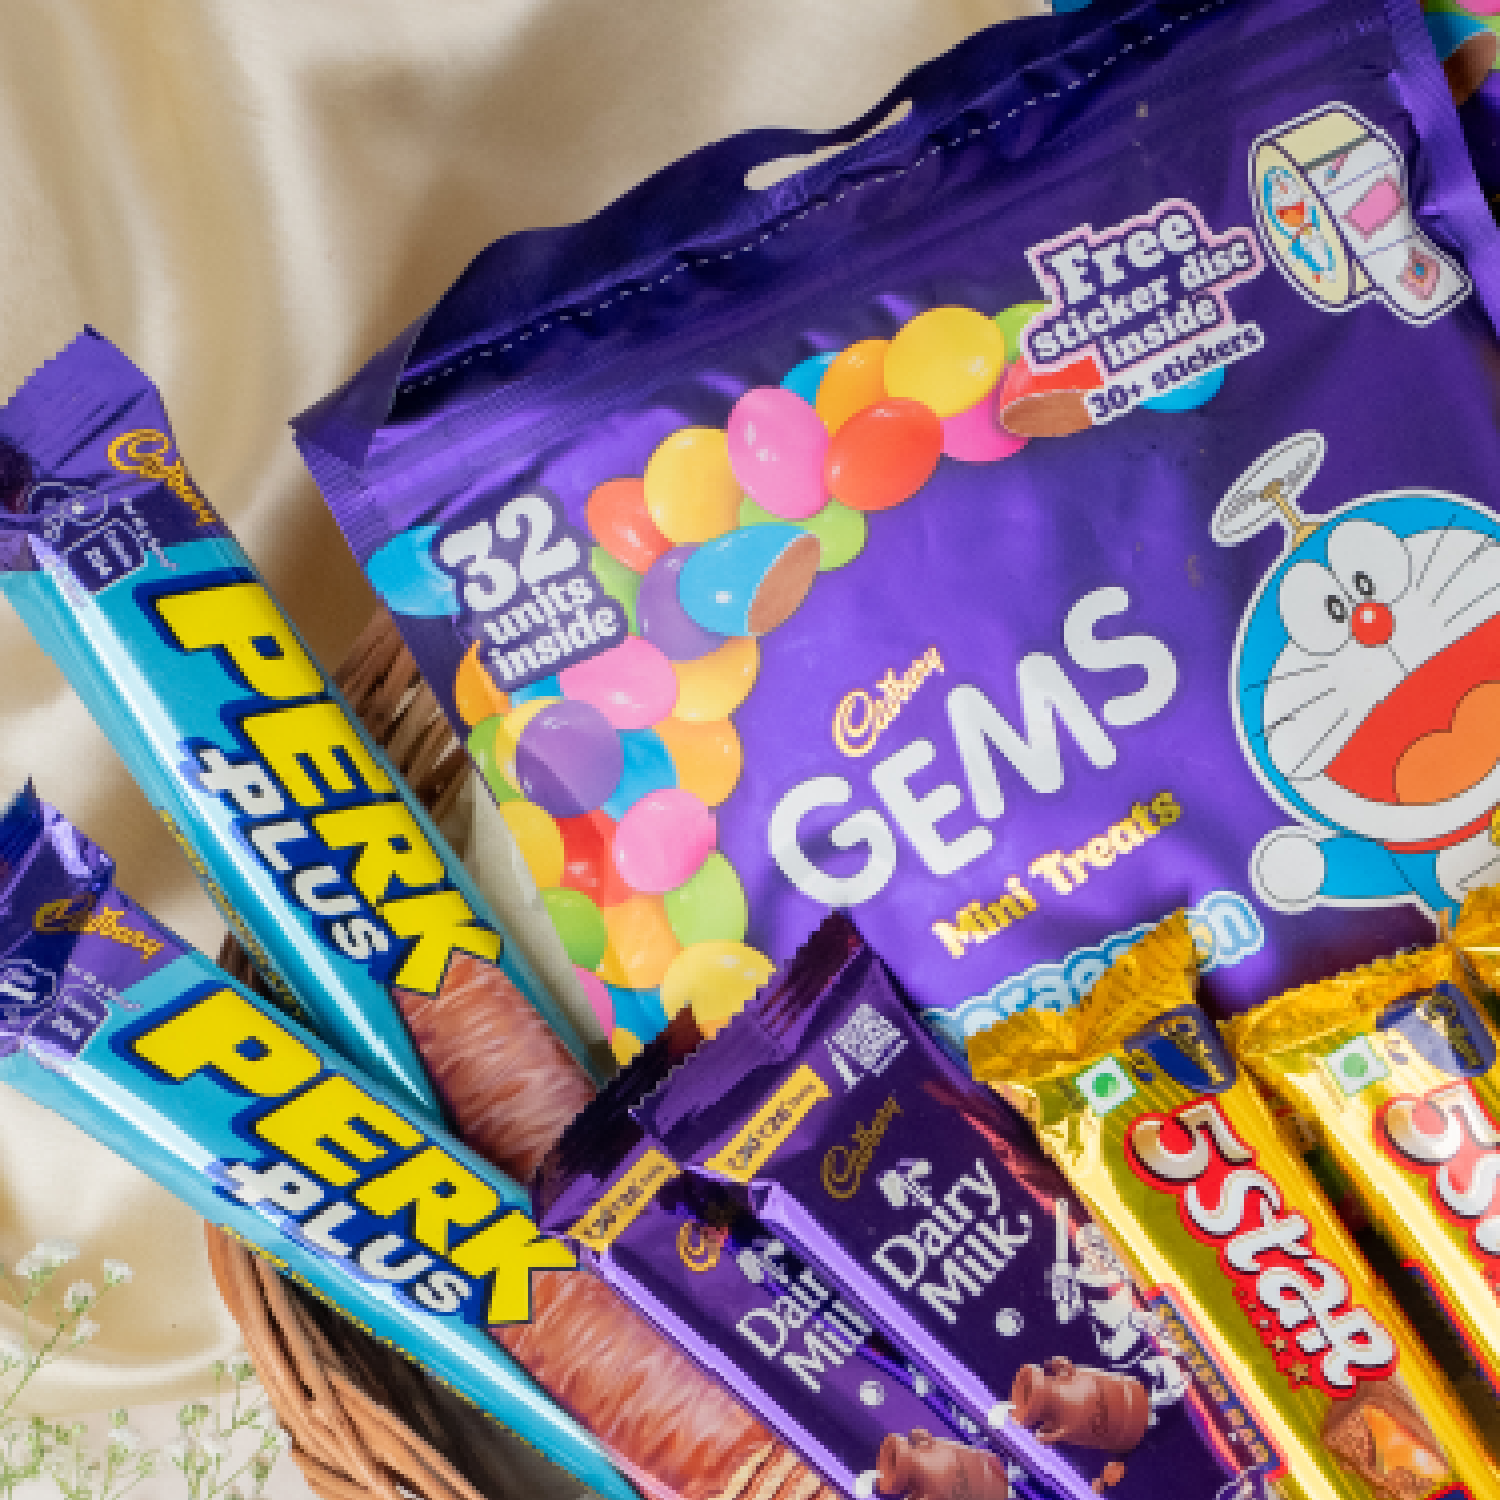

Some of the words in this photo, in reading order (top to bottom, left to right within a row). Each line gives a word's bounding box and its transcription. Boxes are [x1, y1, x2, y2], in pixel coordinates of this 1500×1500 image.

[1034, 279, 1172, 358] sticker
[1179, 240, 1250, 291] disc
[1050, 213, 1198, 302] Free
[1092, 378, 1143, 420] 30+
[1151, 328, 1260, 388] stickers
[1102, 298, 1218, 368] inside
[107, 428, 218, 526] Cadbury
[439, 497, 580, 611] 32
[484, 572, 594, 642] units
[486, 603, 618, 680] inside
[768, 586, 1179, 907] GEMS
[833, 645, 944, 757] Cadbury
[152, 580, 503, 995] PERK
[194, 745, 390, 959] PLUS
[932, 877, 1039, 958] Mini
[1031, 792, 1182, 894] Treats
[131, 987, 579, 1324] PERK
[821, 1097, 901, 1199] Cadbury
[230, 1160, 473, 1313] PLUS
[872, 1160, 1000, 1291] Dairy
[920, 1212, 1033, 1324] Milk
[736, 1270, 830, 1358] Dair
